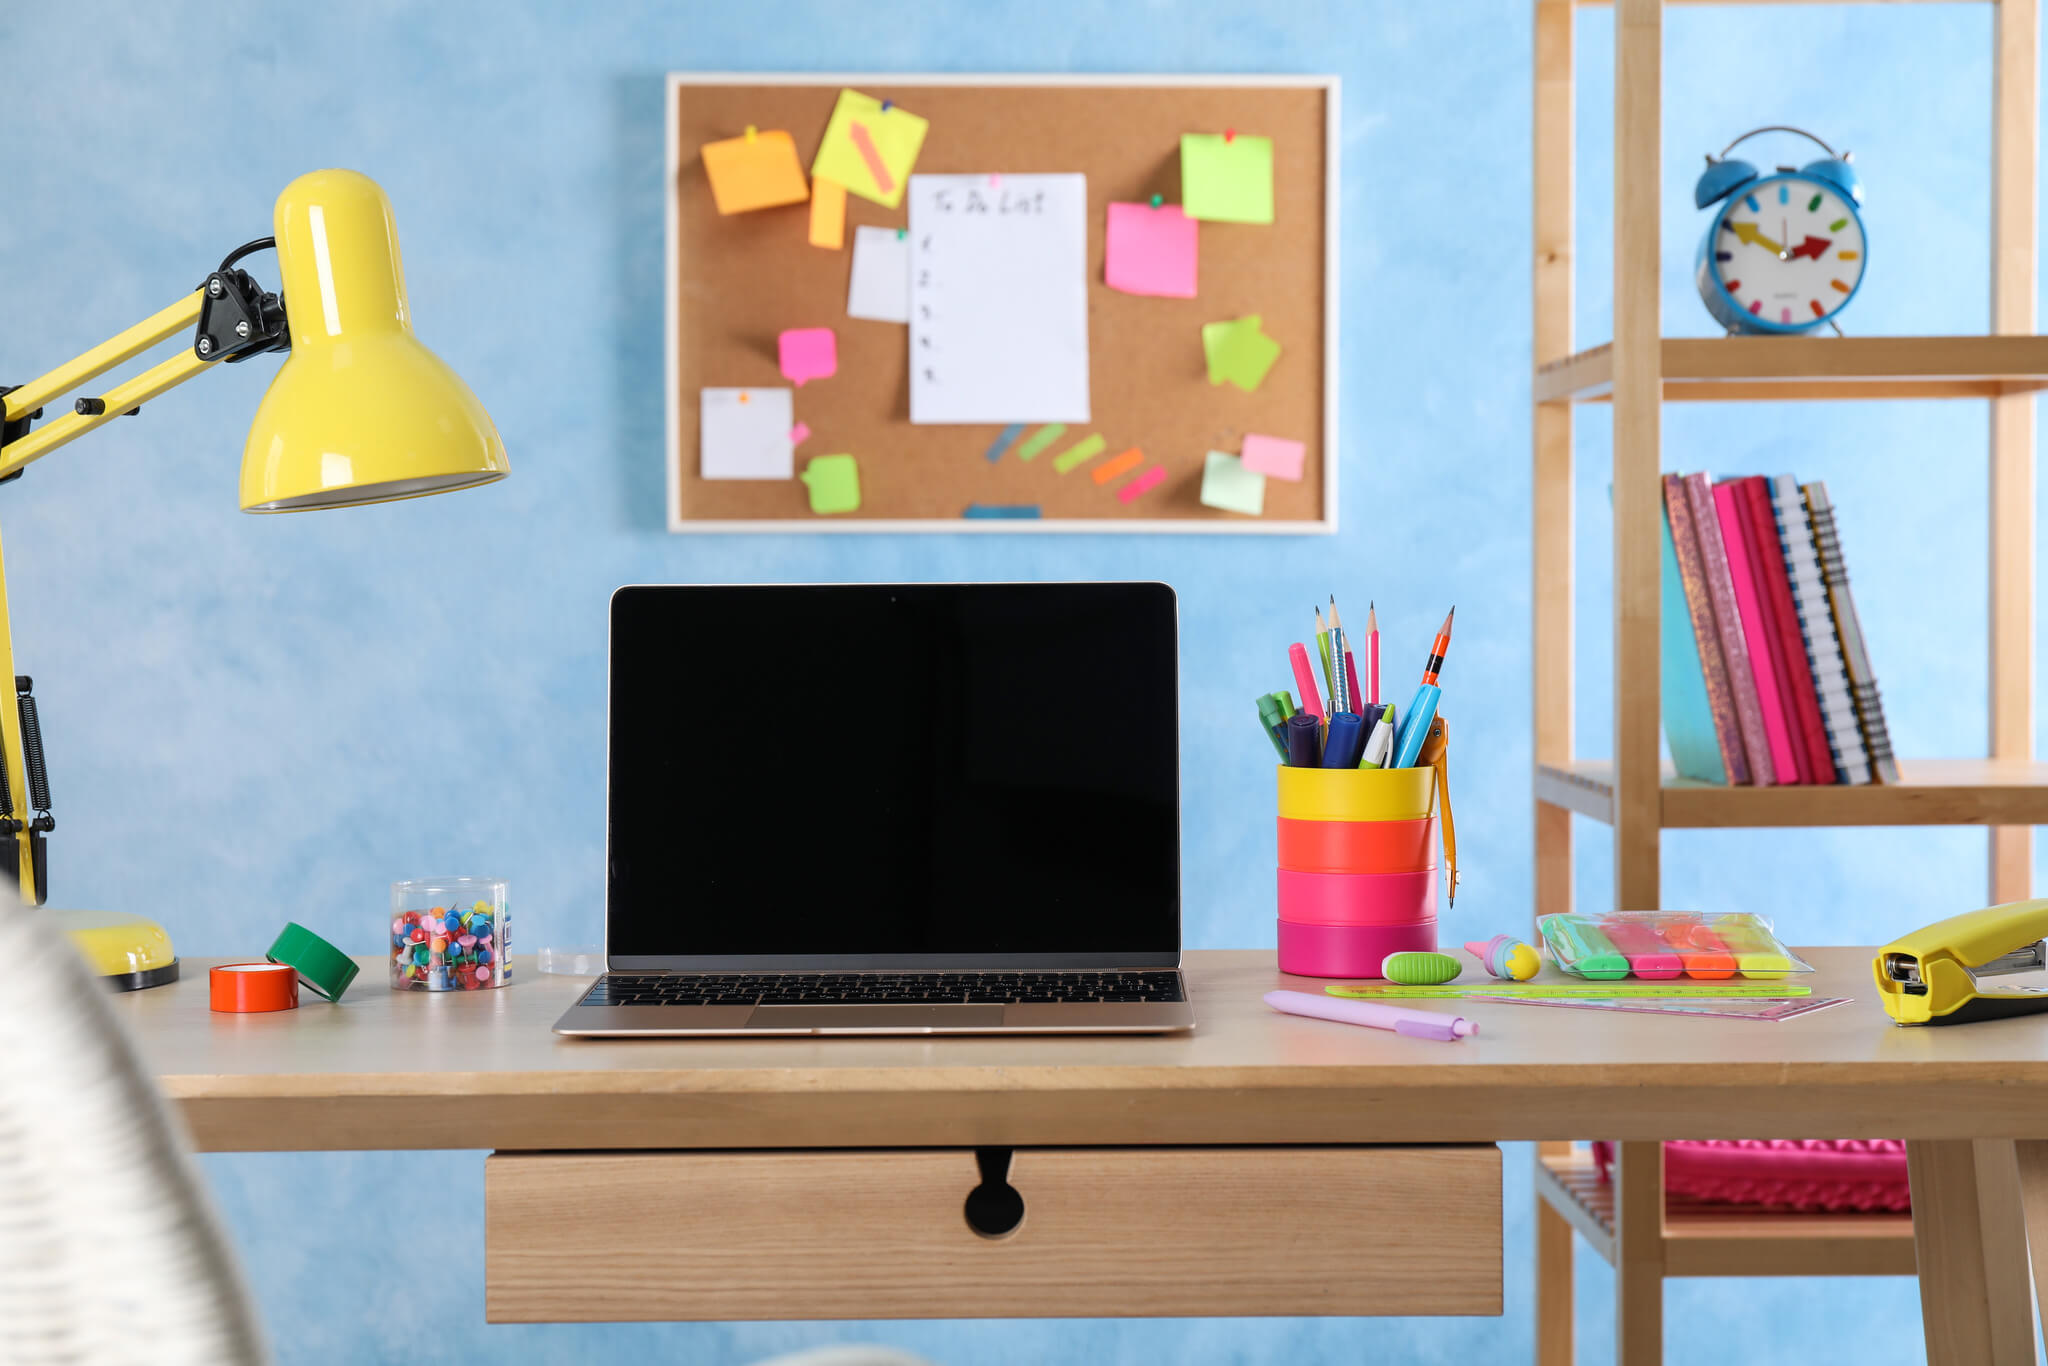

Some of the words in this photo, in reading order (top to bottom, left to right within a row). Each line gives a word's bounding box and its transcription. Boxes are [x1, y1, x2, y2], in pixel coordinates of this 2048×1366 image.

[932, 189, 954, 214] To
[964, 188, 989, 215] Do
[997, 188, 1045, 215] List
